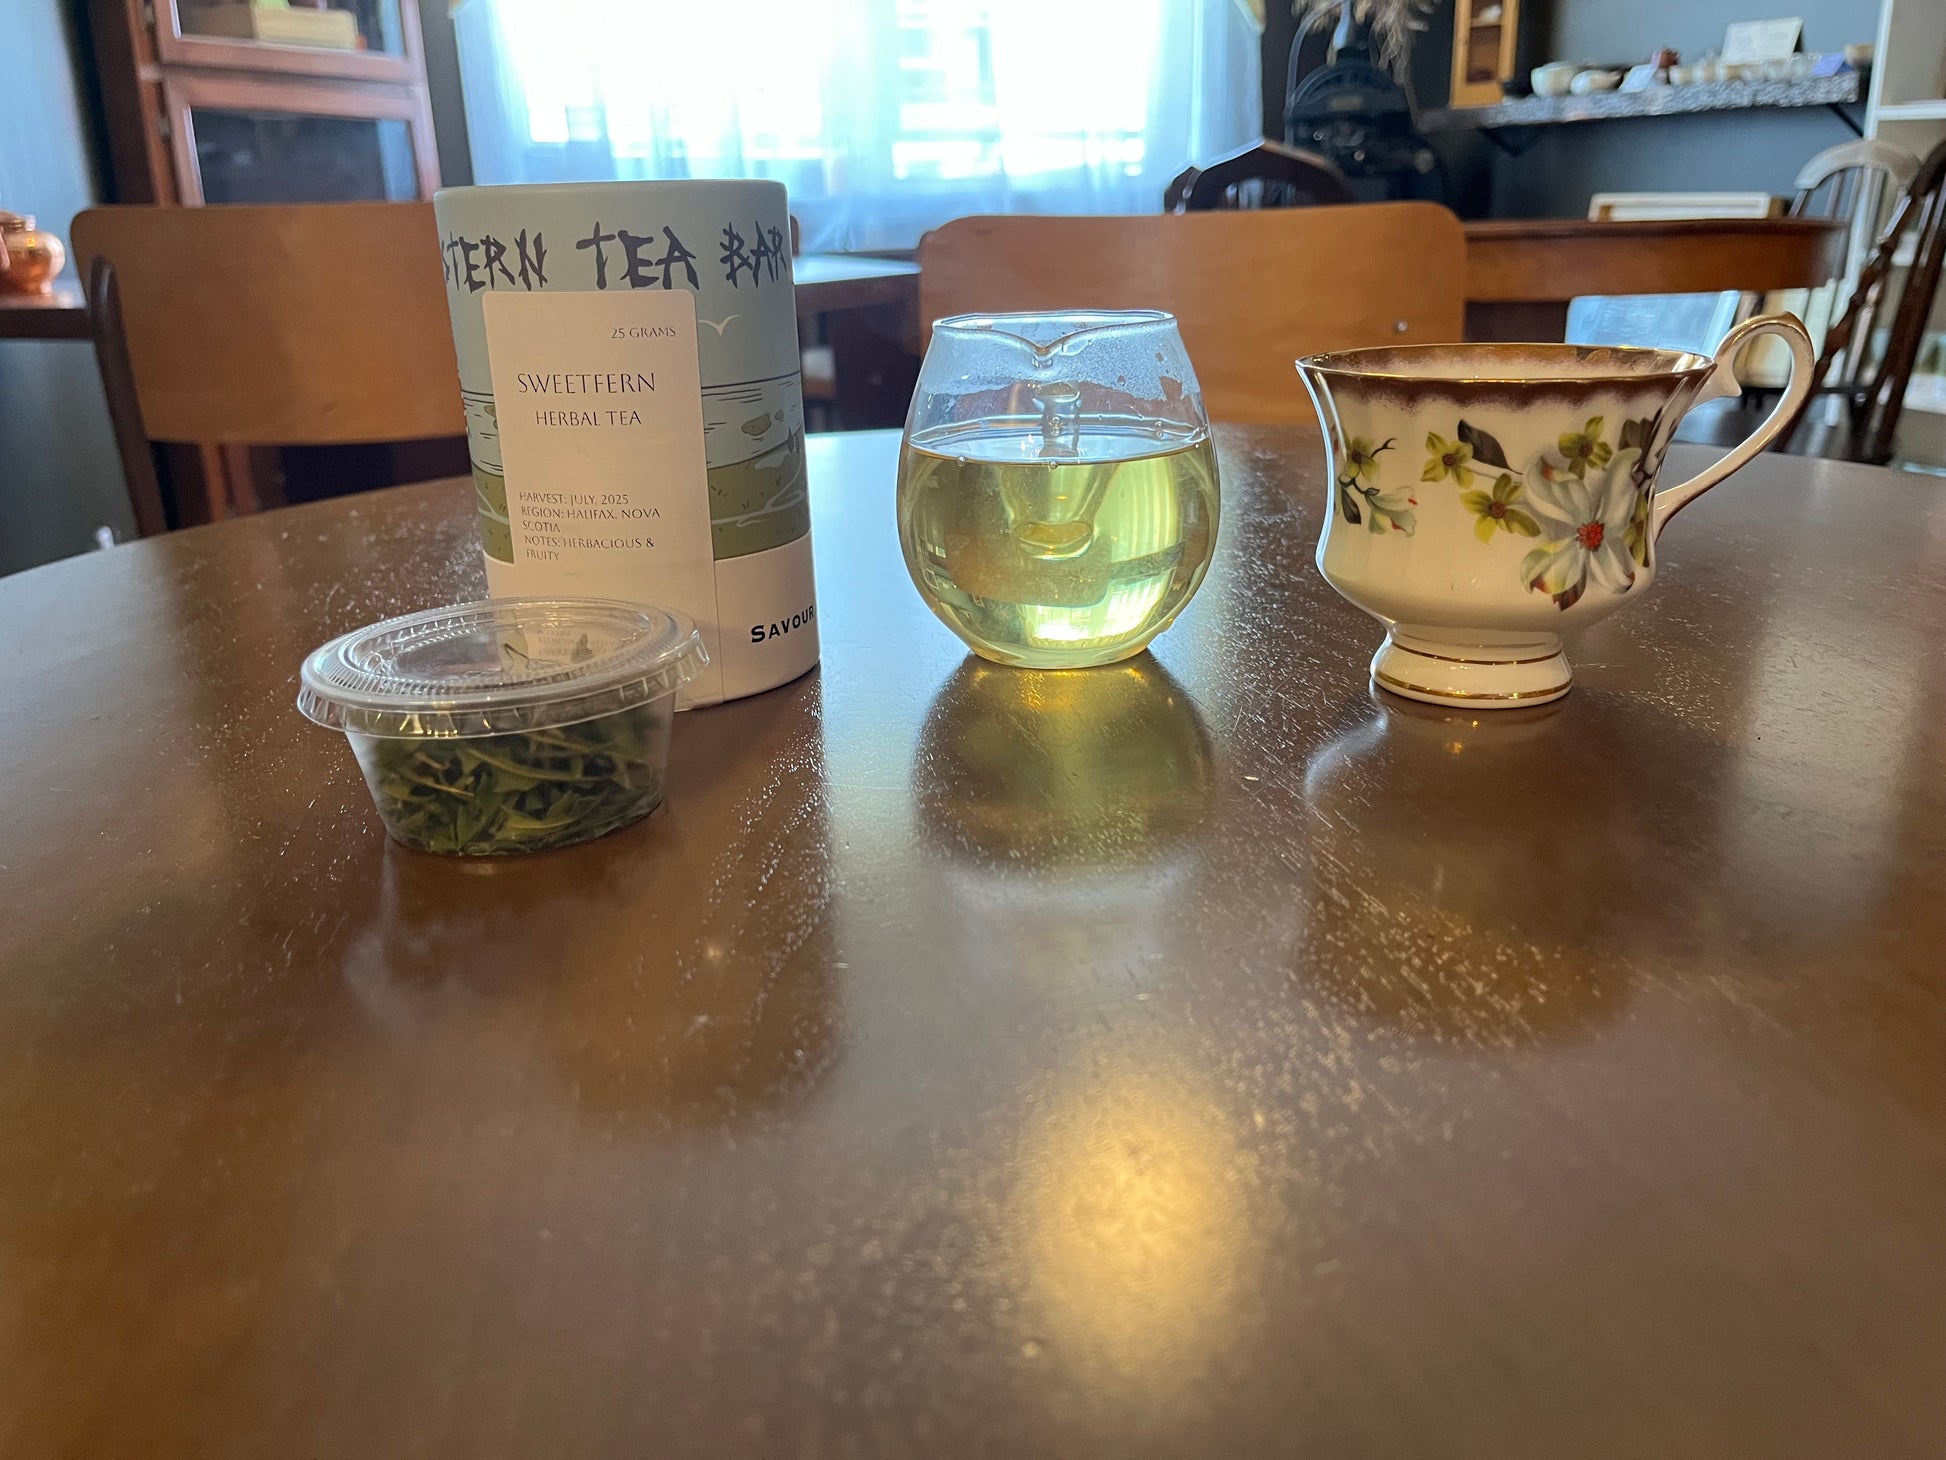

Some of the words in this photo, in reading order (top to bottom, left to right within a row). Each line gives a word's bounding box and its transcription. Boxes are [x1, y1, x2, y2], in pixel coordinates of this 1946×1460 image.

[576, 221, 700, 290] TEA
[719, 220, 788, 289] BAR
[611, 327, 626, 339] 25
[629, 326, 676, 339] GRAMS
[517, 372, 656, 394] SWEETFERN
[535, 411, 601, 426] HERBAL
[605, 410, 642, 426] TEA
[519, 491, 568, 504] HARVEST:
[601, 494, 629, 505] 2025
[521, 505, 564, 519] REGION:
[621, 508, 661, 520] NOVA
[522, 520, 561, 533] SCOTIA
[524, 535, 561, 548] NOTES:
[563, 537, 642, 549] HERBACIOUS
[645, 537, 655, 548] &
[526, 548, 560, 561] FRUITY
[750, 605, 814, 643] SAVOUR
